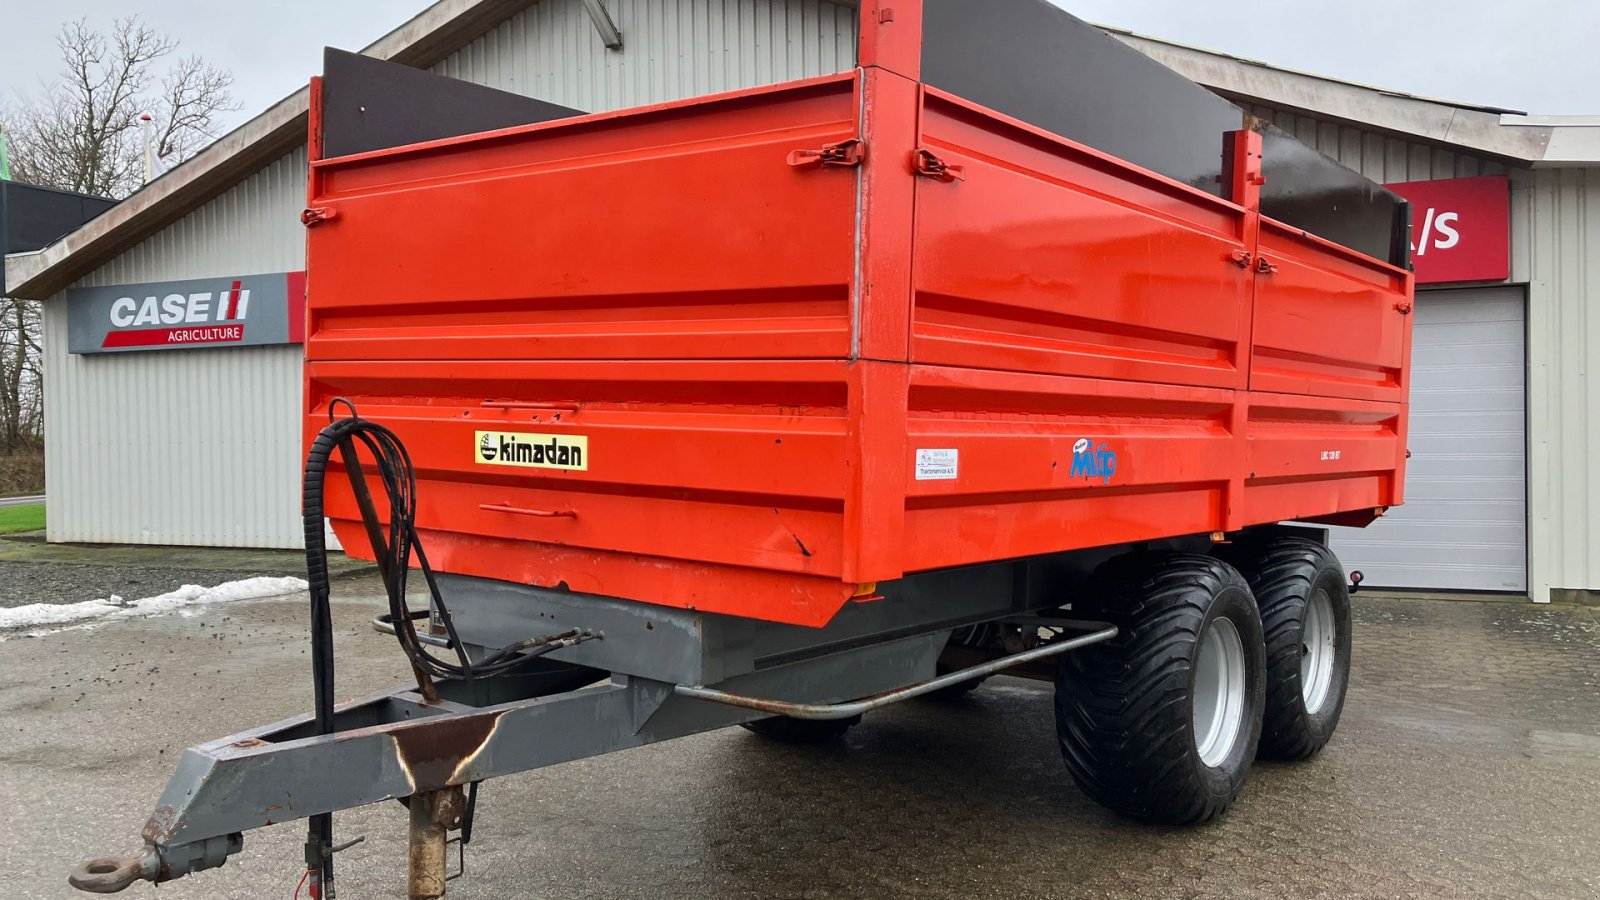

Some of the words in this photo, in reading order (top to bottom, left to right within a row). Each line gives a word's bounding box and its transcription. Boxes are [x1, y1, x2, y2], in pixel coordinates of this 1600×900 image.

[1410, 207, 1460, 256] /S
[109, 292, 212, 327] CASE
[168, 327, 240, 342] AGRICULTURE
[500, 435, 582, 466] kimadan
